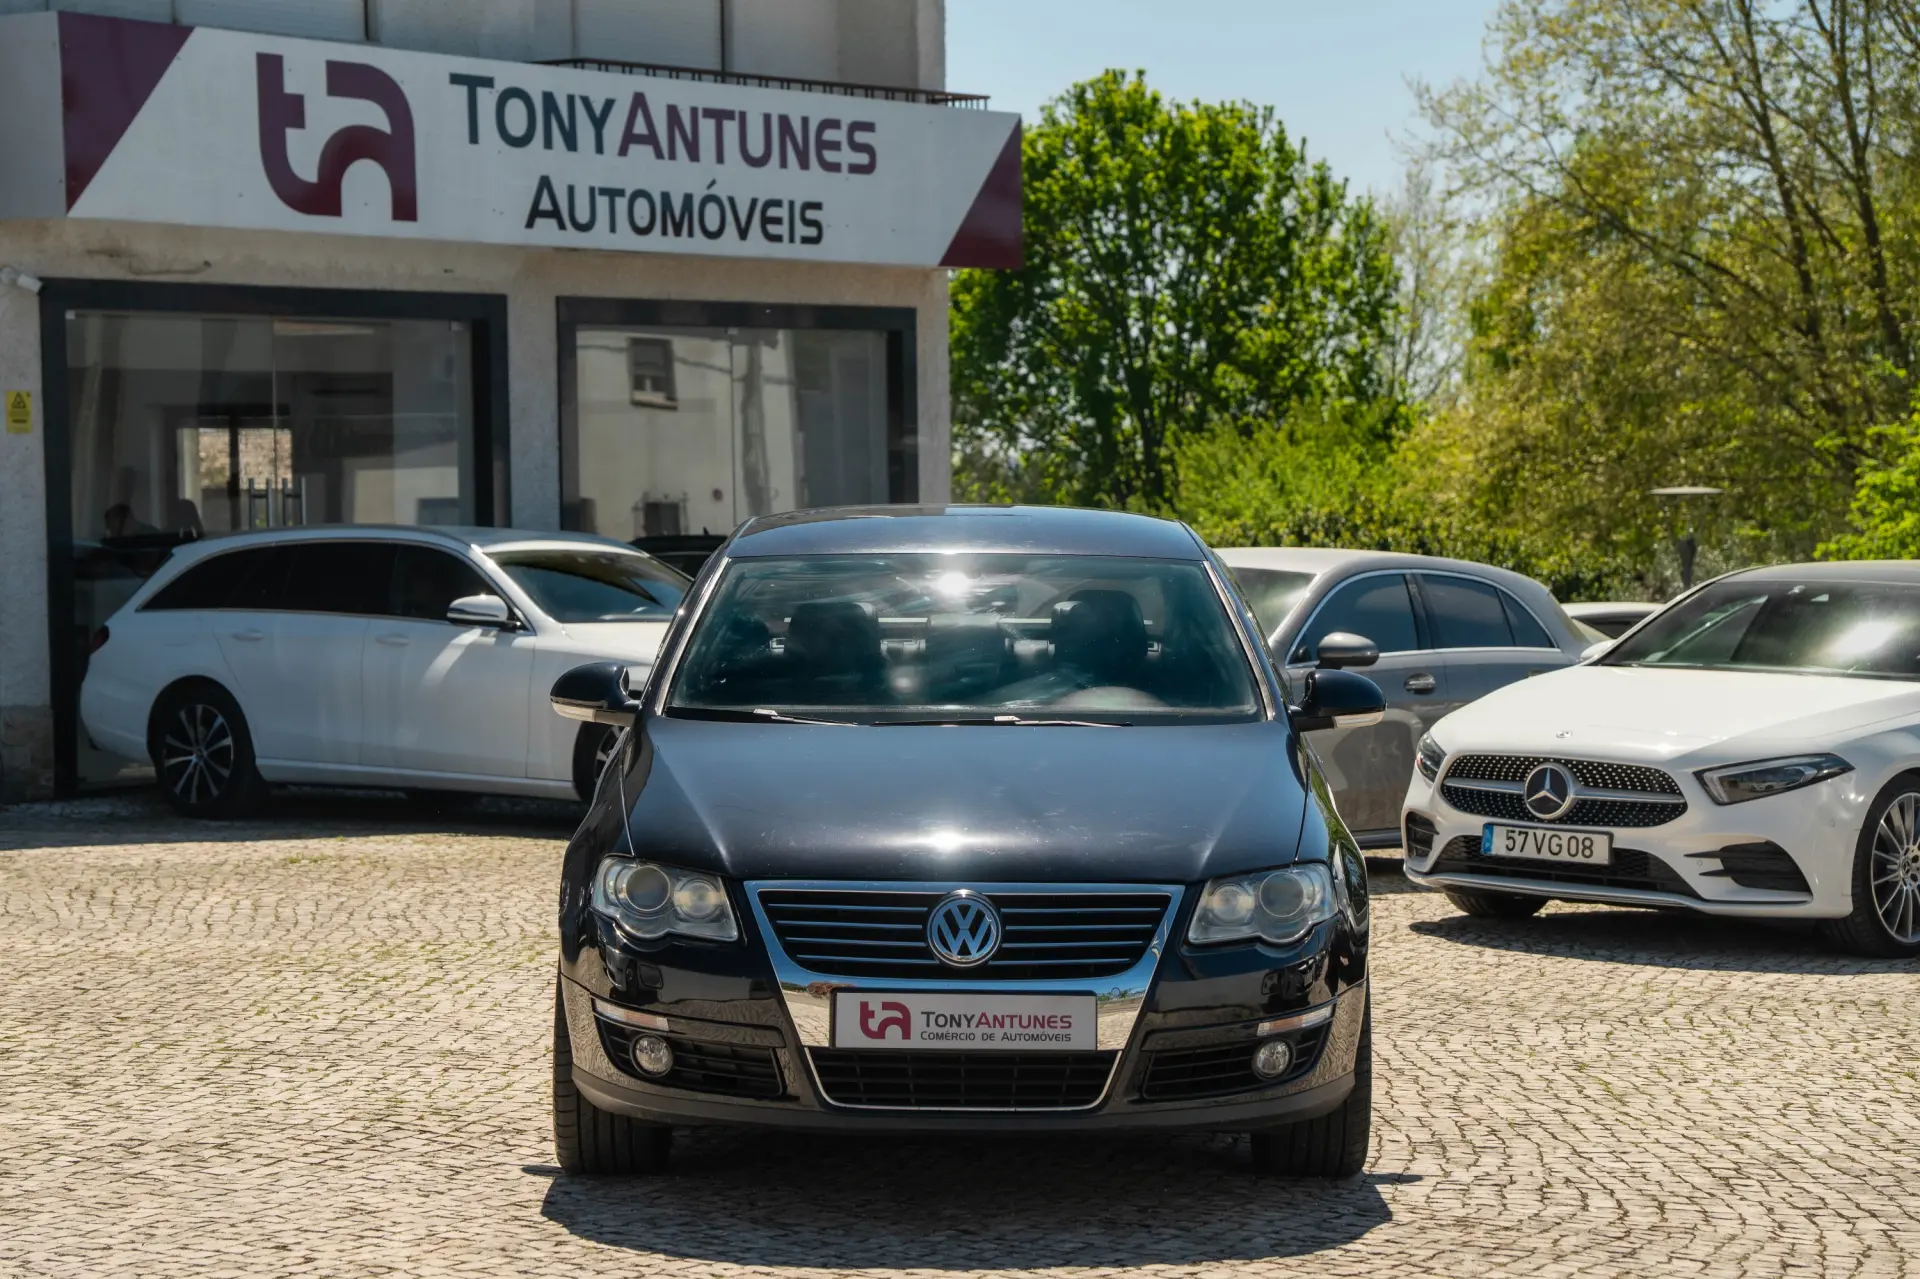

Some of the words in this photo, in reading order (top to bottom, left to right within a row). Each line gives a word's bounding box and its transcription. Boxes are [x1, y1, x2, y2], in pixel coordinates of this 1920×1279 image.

[524, 174, 824, 246] AUTOMÓVEIS
[920, 1030, 976, 1041] COMÉRCIO
[981, 1032, 995, 1041] DE
[1001, 1031, 1072, 1042] AUTOMÓVEIS
